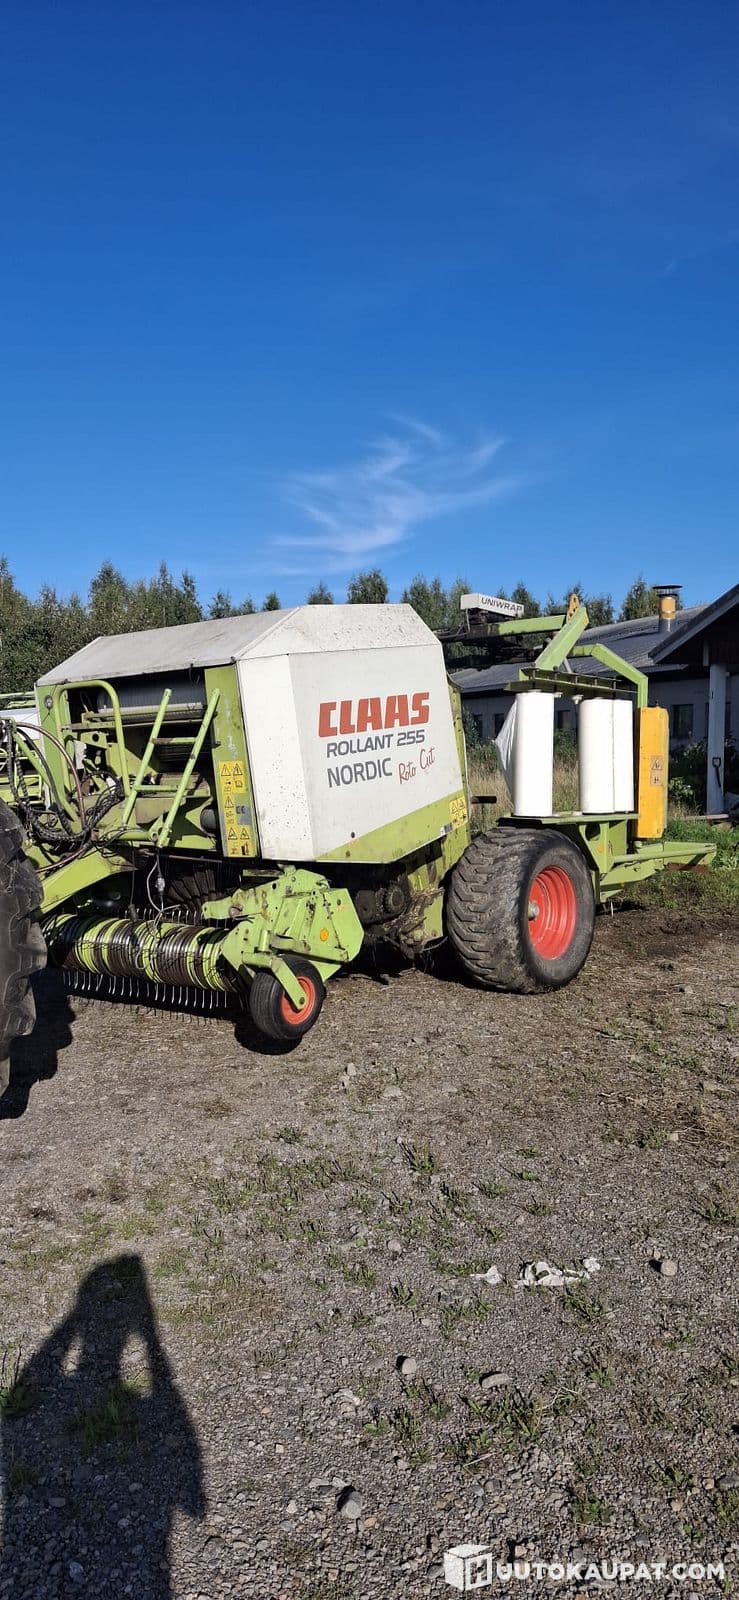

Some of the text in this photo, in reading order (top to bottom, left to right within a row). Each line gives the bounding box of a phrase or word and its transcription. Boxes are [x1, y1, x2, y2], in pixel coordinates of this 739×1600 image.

[481, 597, 522, 611] UNIWRAP
[318, 692, 429, 737] CLAAS
[326, 729, 425, 758] ROLLANT 255
[327, 747, 435, 788] NORDIC Roto Cut
